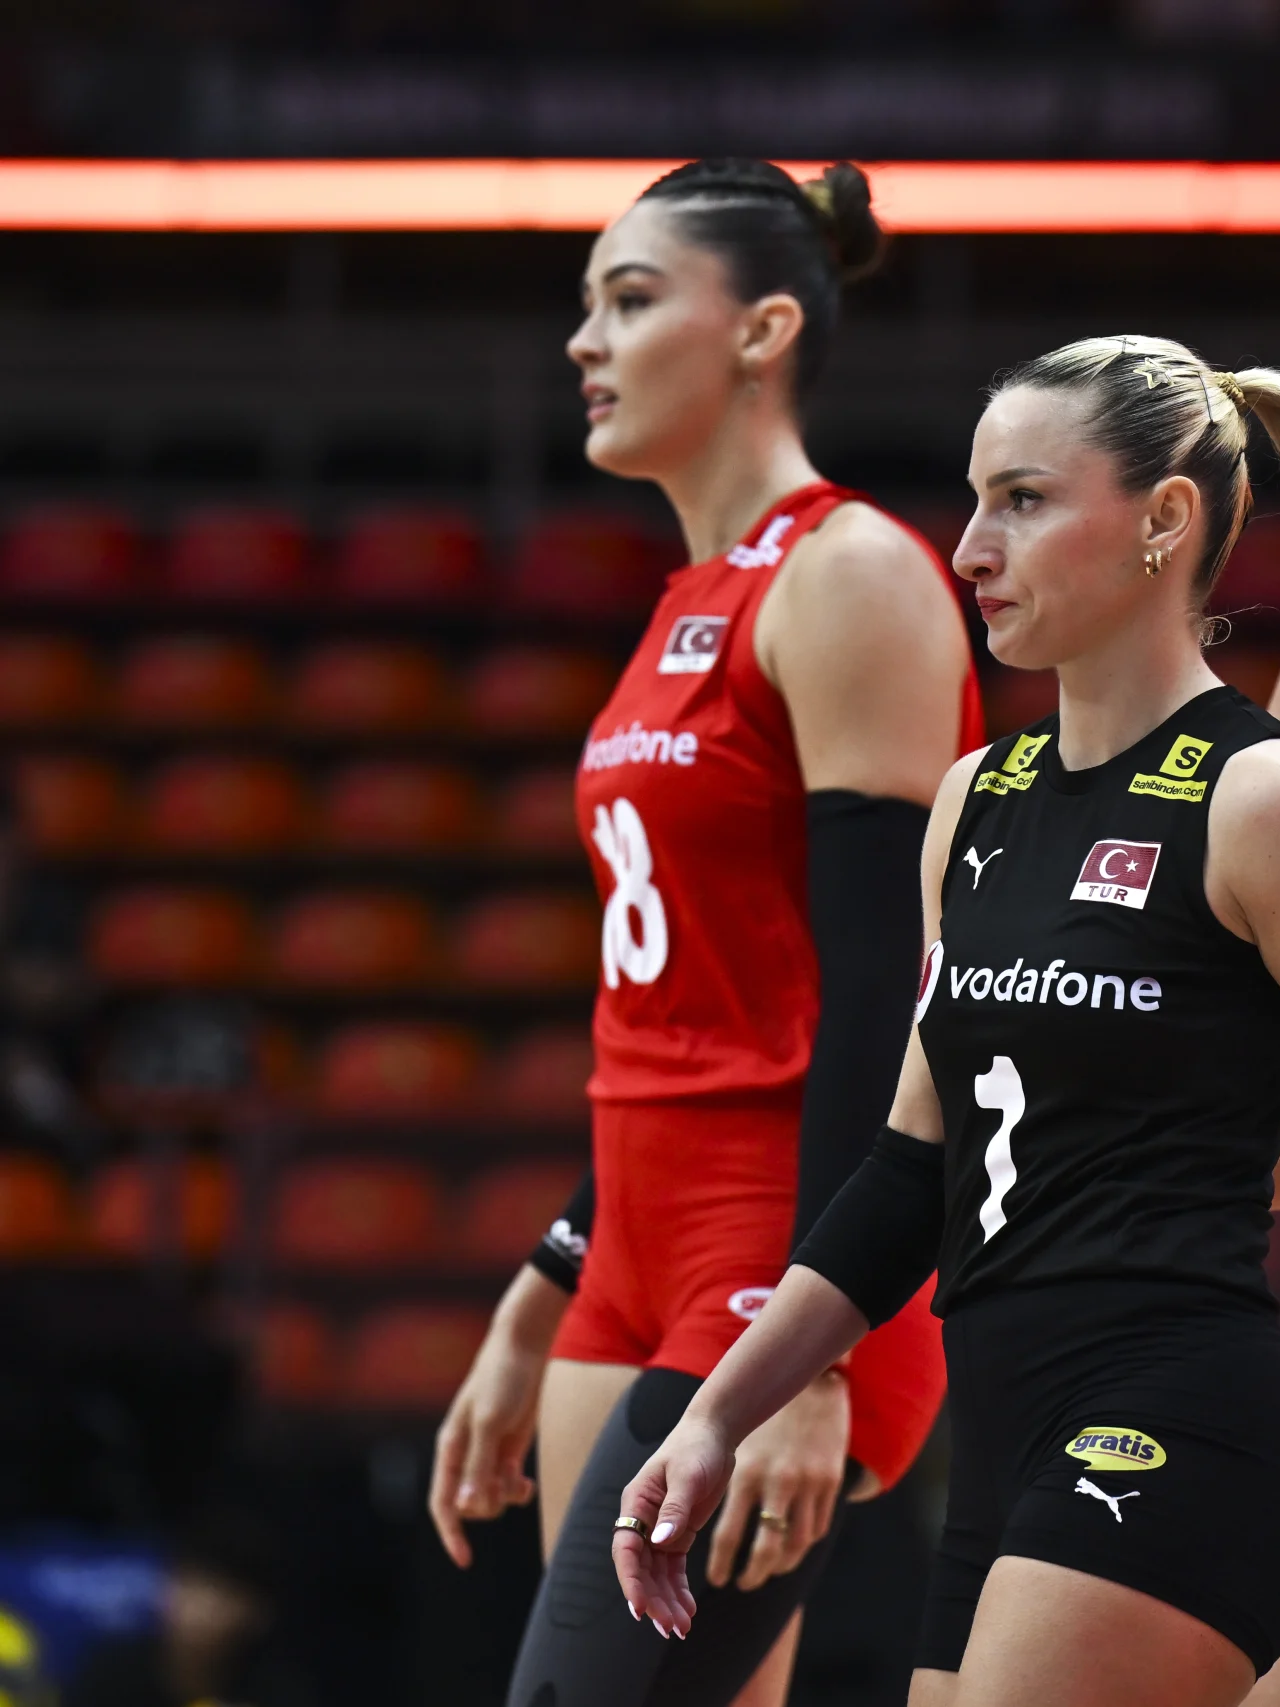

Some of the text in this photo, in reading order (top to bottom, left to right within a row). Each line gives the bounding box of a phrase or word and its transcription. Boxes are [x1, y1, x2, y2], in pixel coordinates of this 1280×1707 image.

[1175, 746, 1202, 770] S
[1133, 780, 1204, 797] sahibinden.com
[591, 796, 669, 990] 18
[1088, 885, 1129, 901] TUR
[950, 957, 1163, 1012] vodafone
[974, 1055, 1026, 1245] 1
[1071, 1434, 1156, 1461] gratis
